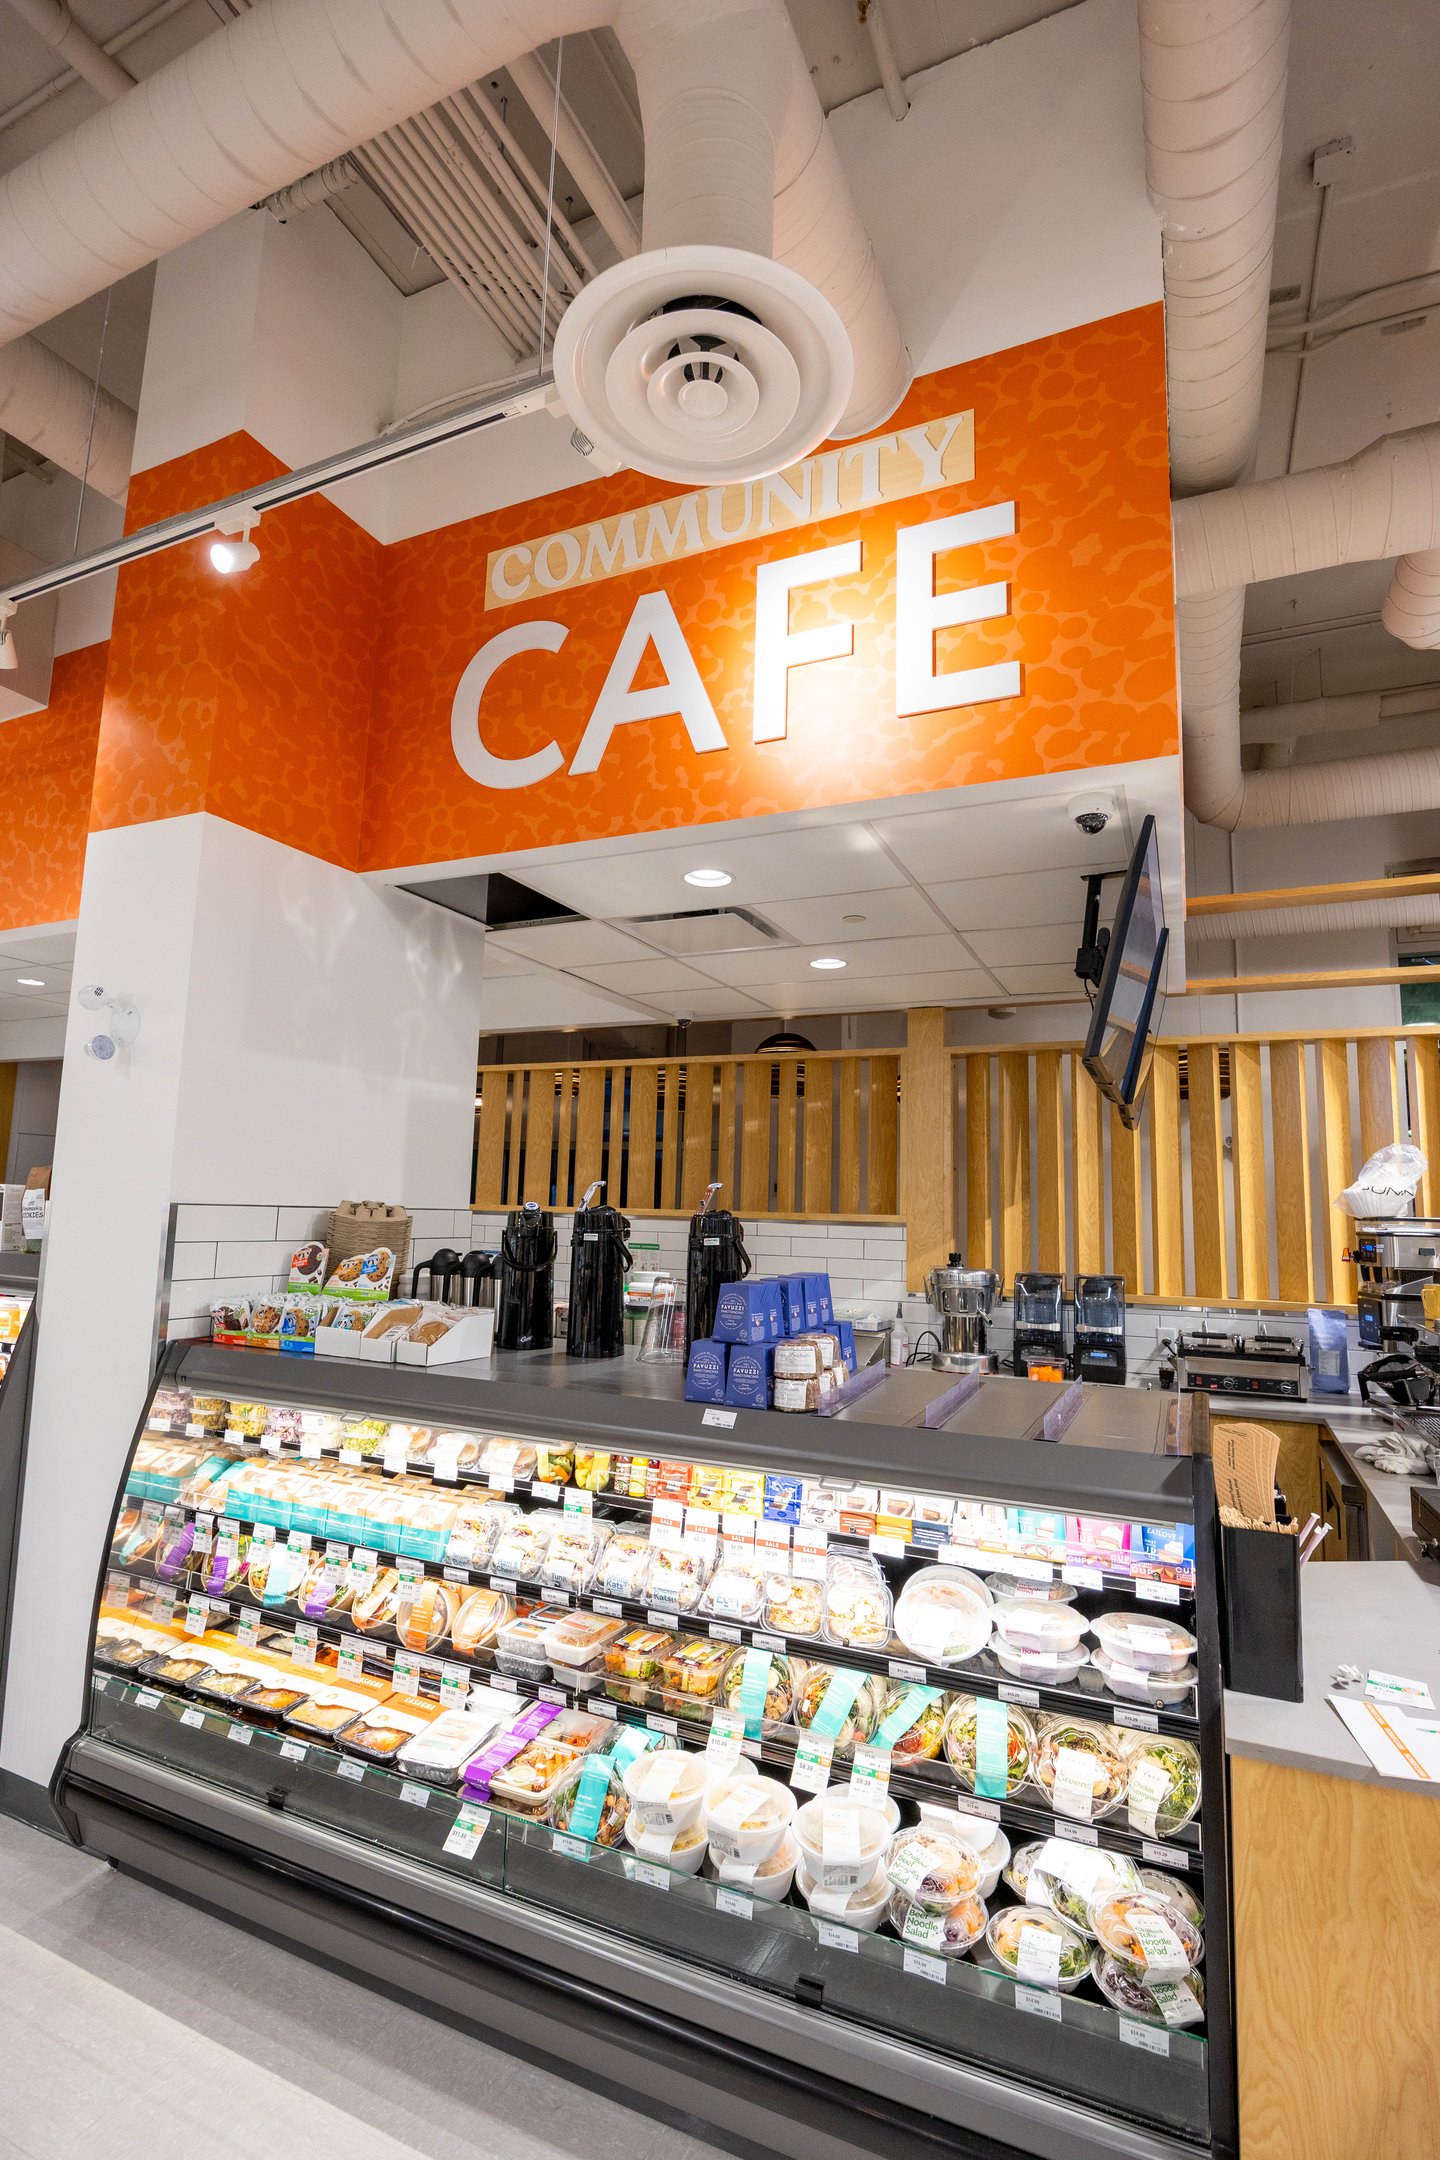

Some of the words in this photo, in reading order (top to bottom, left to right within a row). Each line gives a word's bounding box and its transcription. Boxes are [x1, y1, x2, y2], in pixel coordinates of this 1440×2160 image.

[490, 415, 963, 600] COMMUNITY
[450, 500, 1024, 790] CAFE
[660, 1518, 673, 1526] SALE
[695, 1525, 708, 1533] SALE
[1147, 1527, 1177, 1541] EATLOVE
[765, 1540, 779, 1549] SALE
[802, 1547, 817, 1555] SALE
[551, 1572, 567, 1581] Tuna
[653, 1592, 677, 1604] Katsu
[856, 1778, 871, 1787] $9.39
[906, 1917, 939, 1932] Noodle
[905, 1925, 930, 1939] Salad
[1141, 1937, 1172, 1947] Noodle
[1144, 1945, 1169, 1956] Salad
[1151, 1983, 1180, 1995] Noodle
[1156, 1992, 1179, 2005] Salad
[1130, 2029, 1146, 2038] $14.99
